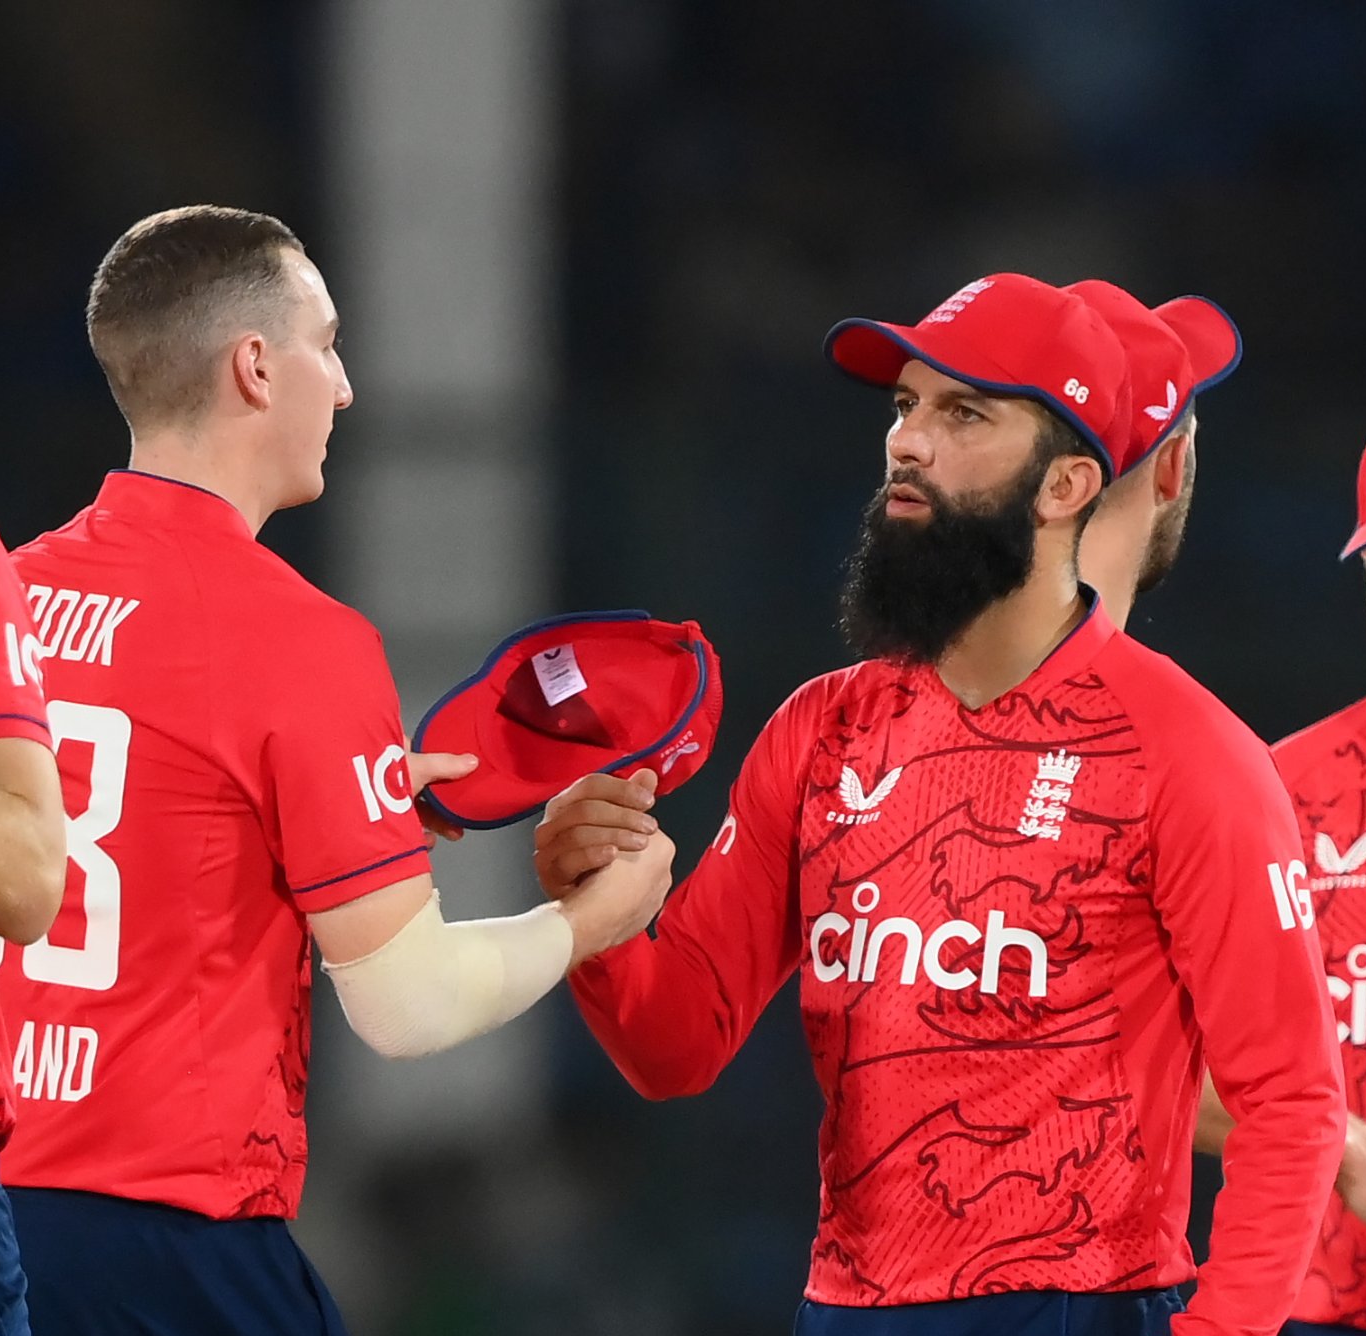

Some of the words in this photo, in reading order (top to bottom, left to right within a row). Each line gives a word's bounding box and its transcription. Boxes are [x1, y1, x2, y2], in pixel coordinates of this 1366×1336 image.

[1063, 377, 1090, 405] 66
[1266, 859, 1315, 931] IG
[809, 881, 1048, 997] cinch
